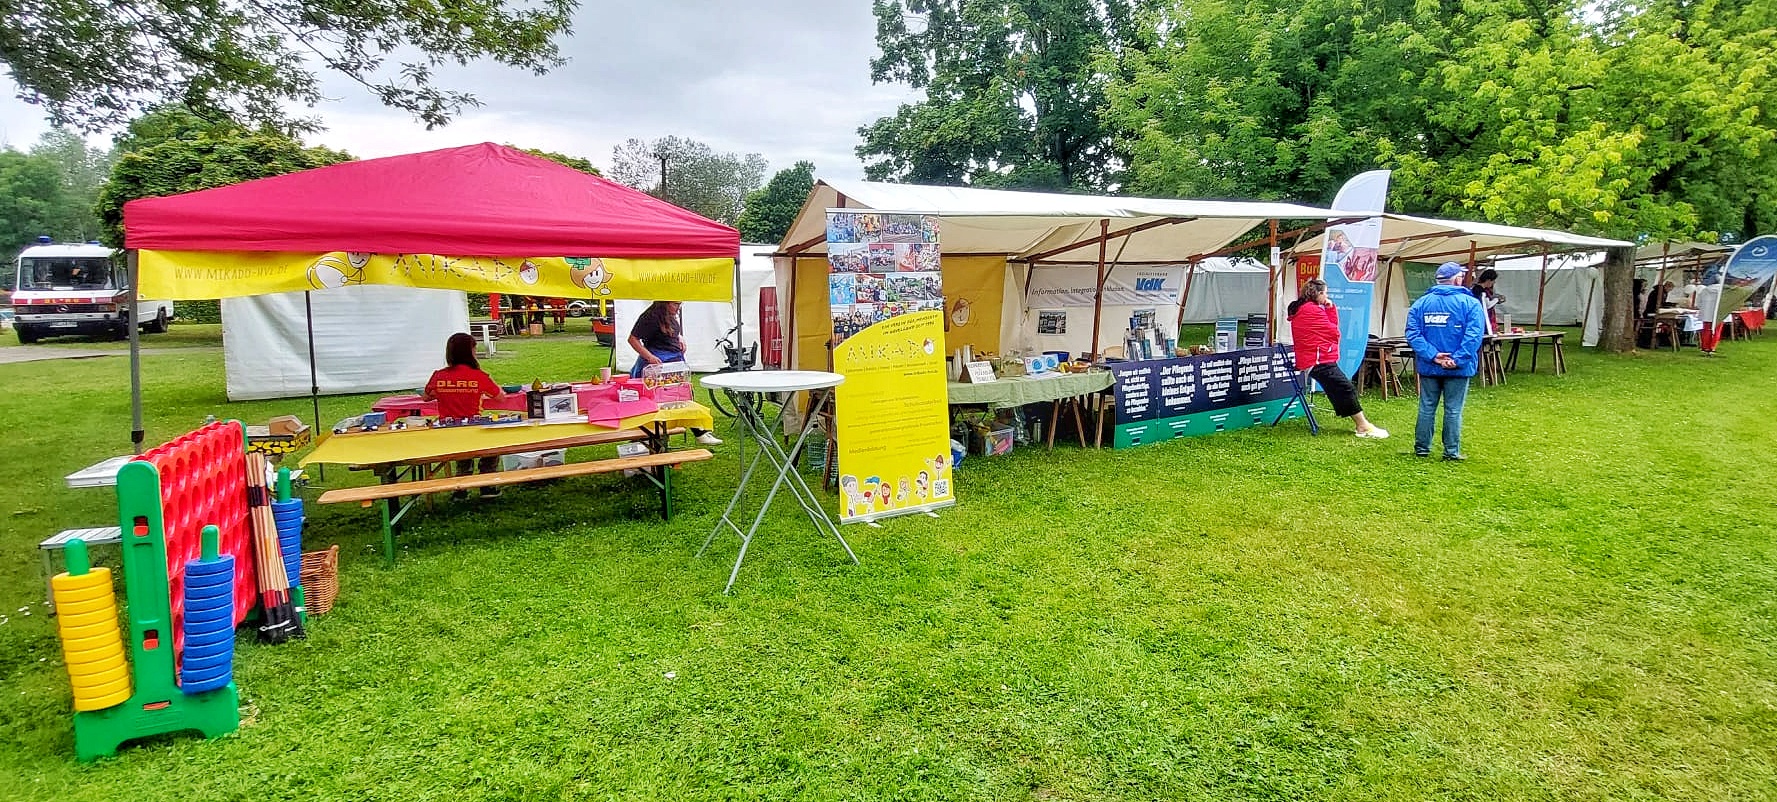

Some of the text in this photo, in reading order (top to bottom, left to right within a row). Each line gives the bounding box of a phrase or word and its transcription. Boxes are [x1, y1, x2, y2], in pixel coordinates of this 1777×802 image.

[1135, 277, 1167, 291] VdK
[1423, 315, 1450, 324] VdK
[436, 380, 479, 388] DLRG
